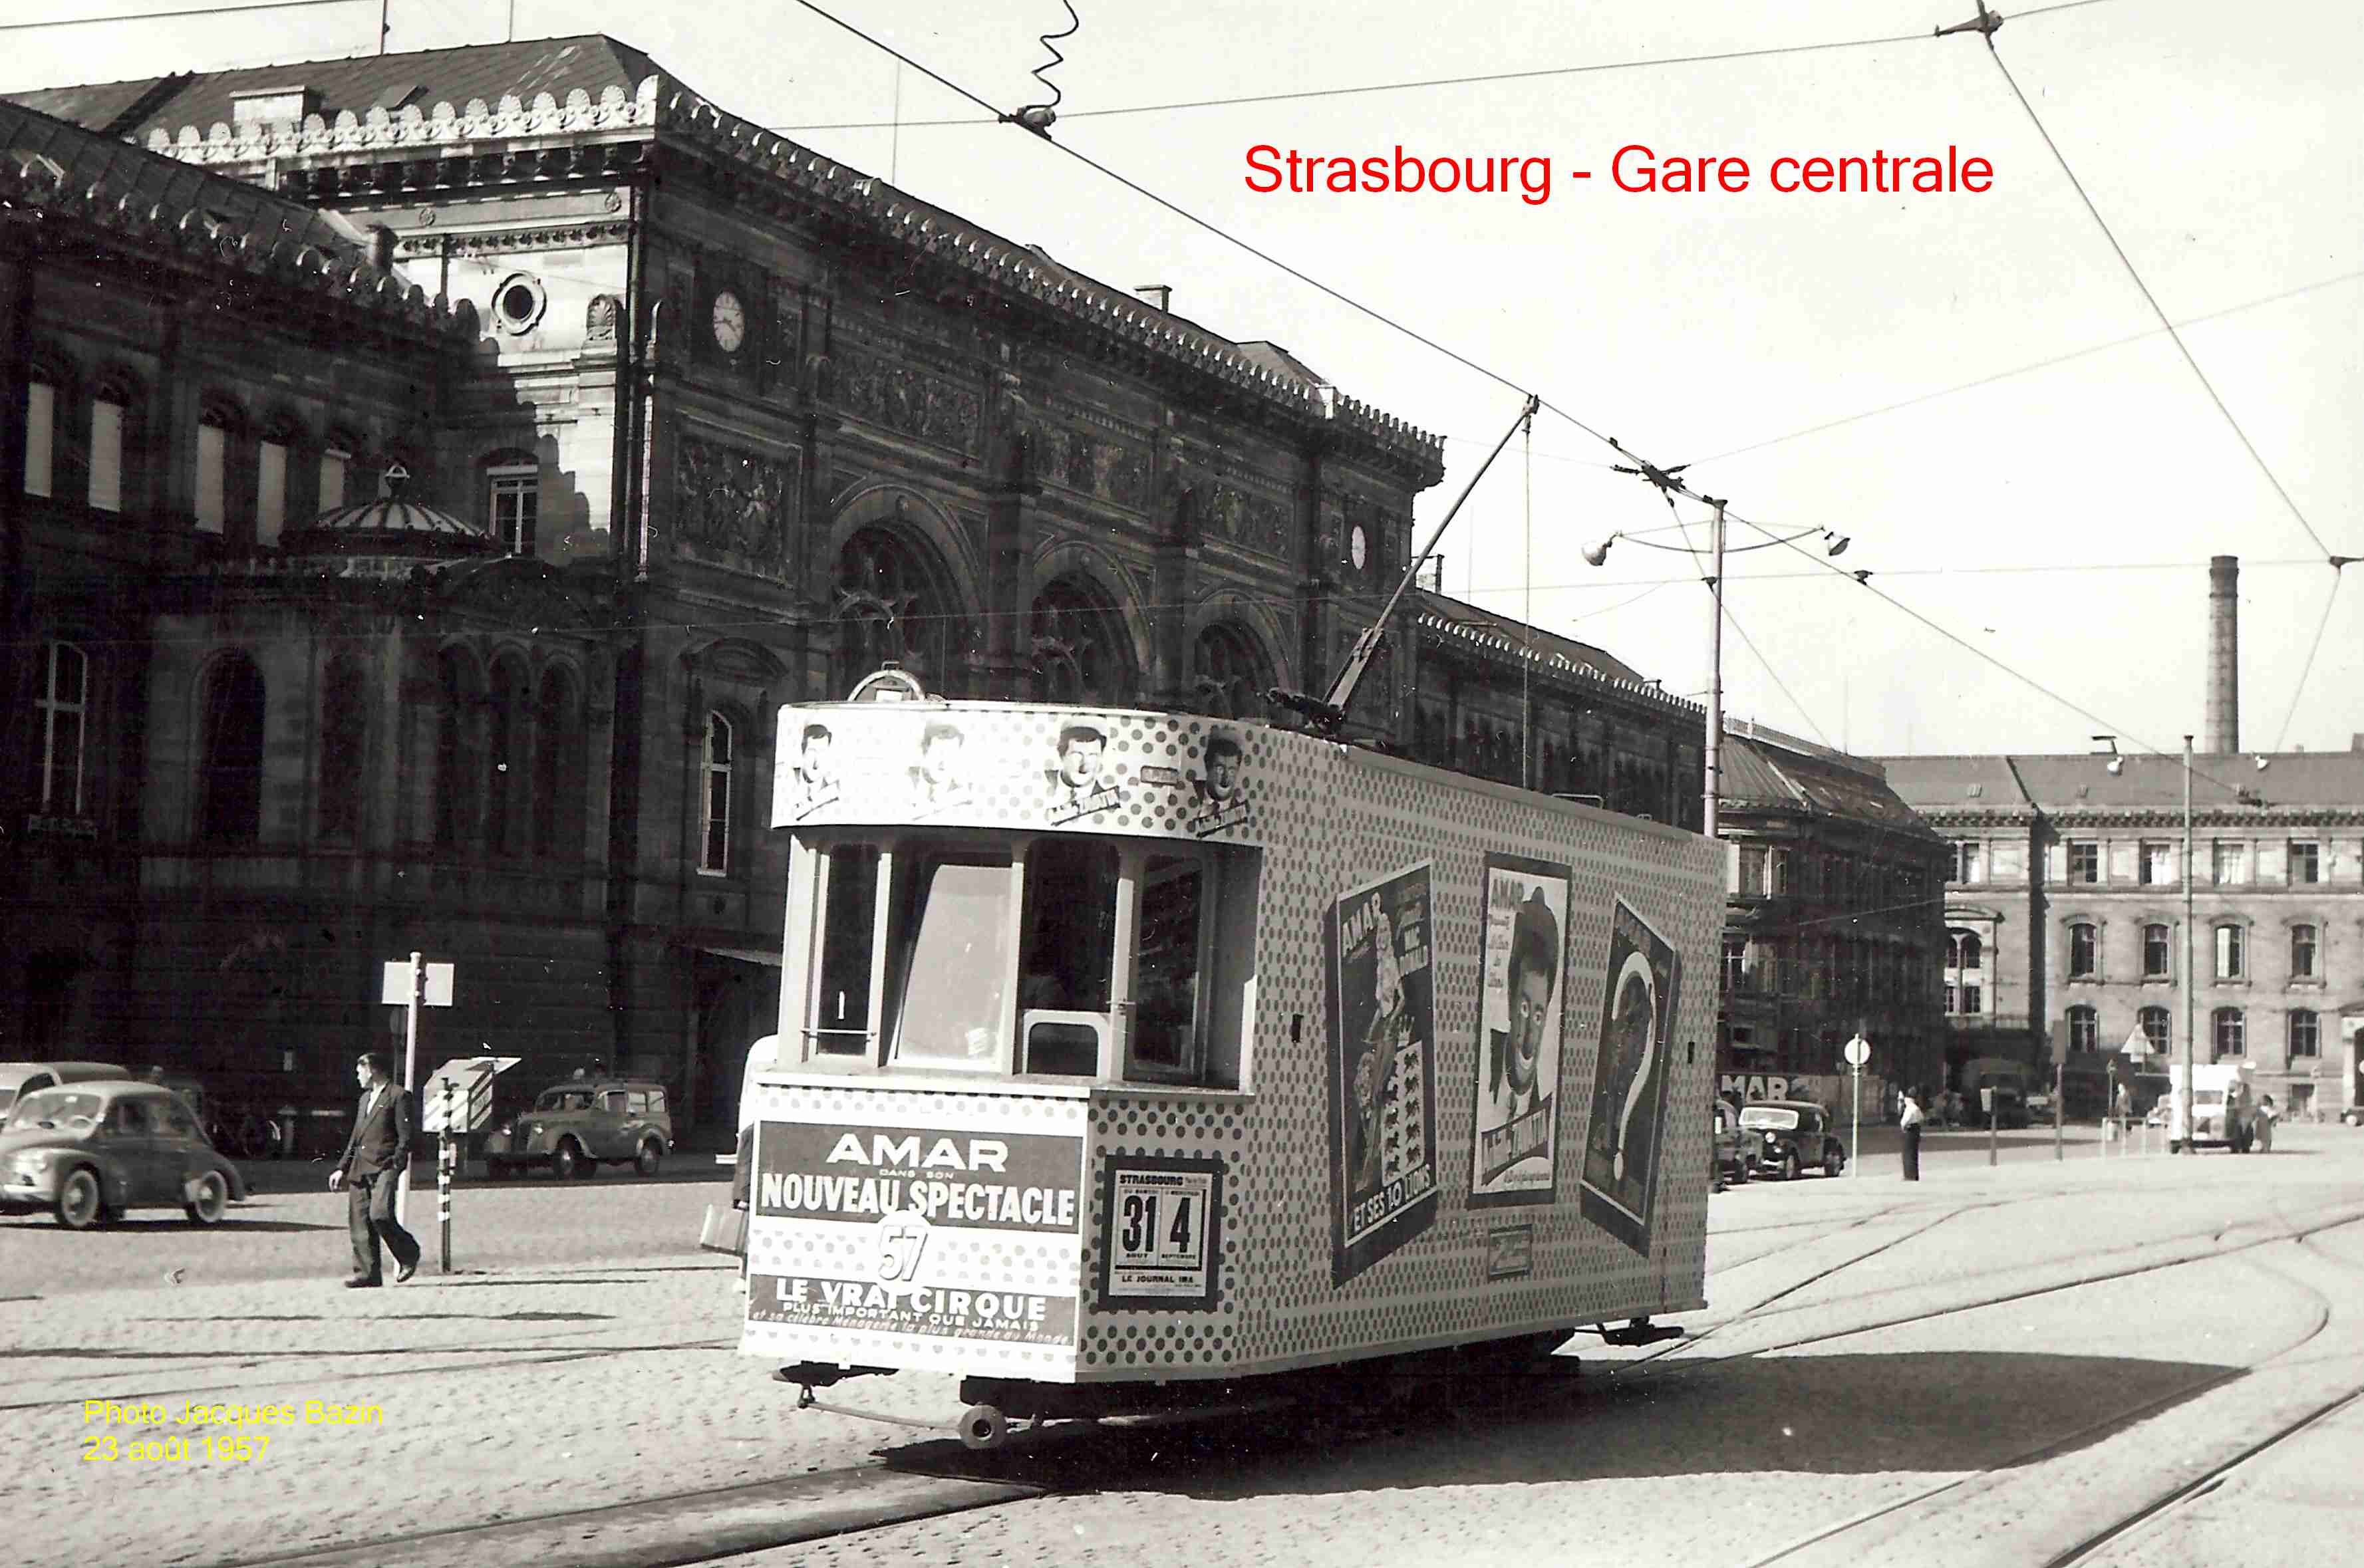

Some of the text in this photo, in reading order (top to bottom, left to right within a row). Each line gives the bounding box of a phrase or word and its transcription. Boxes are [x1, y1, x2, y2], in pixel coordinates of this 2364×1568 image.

[1343, 892, 1381, 958] AMAR
[826, 1134, 1009, 1172] AMAR
[879, 1168, 953, 1180] DANS SON
[761, 1173, 1075, 1226] NOUVEAU SPECTACLE
[1119, 1174, 1183, 1186] STRASBOURG
[1122, 1195, 1157, 1252] 31
[1169, 1197, 1191, 1253] 4
[1354, 1202, 1366, 1232] ET
[1367, 1191, 1385, 1224] SES
[1386, 1182, 1402, 1211] 10
[879, 1224, 929, 1281] 57
[776, 1278, 1046, 1320] LE VRAI CIRQUE
[783, 1301, 1039, 1332] PLUS IMPORTANT QUE JAMAIS
